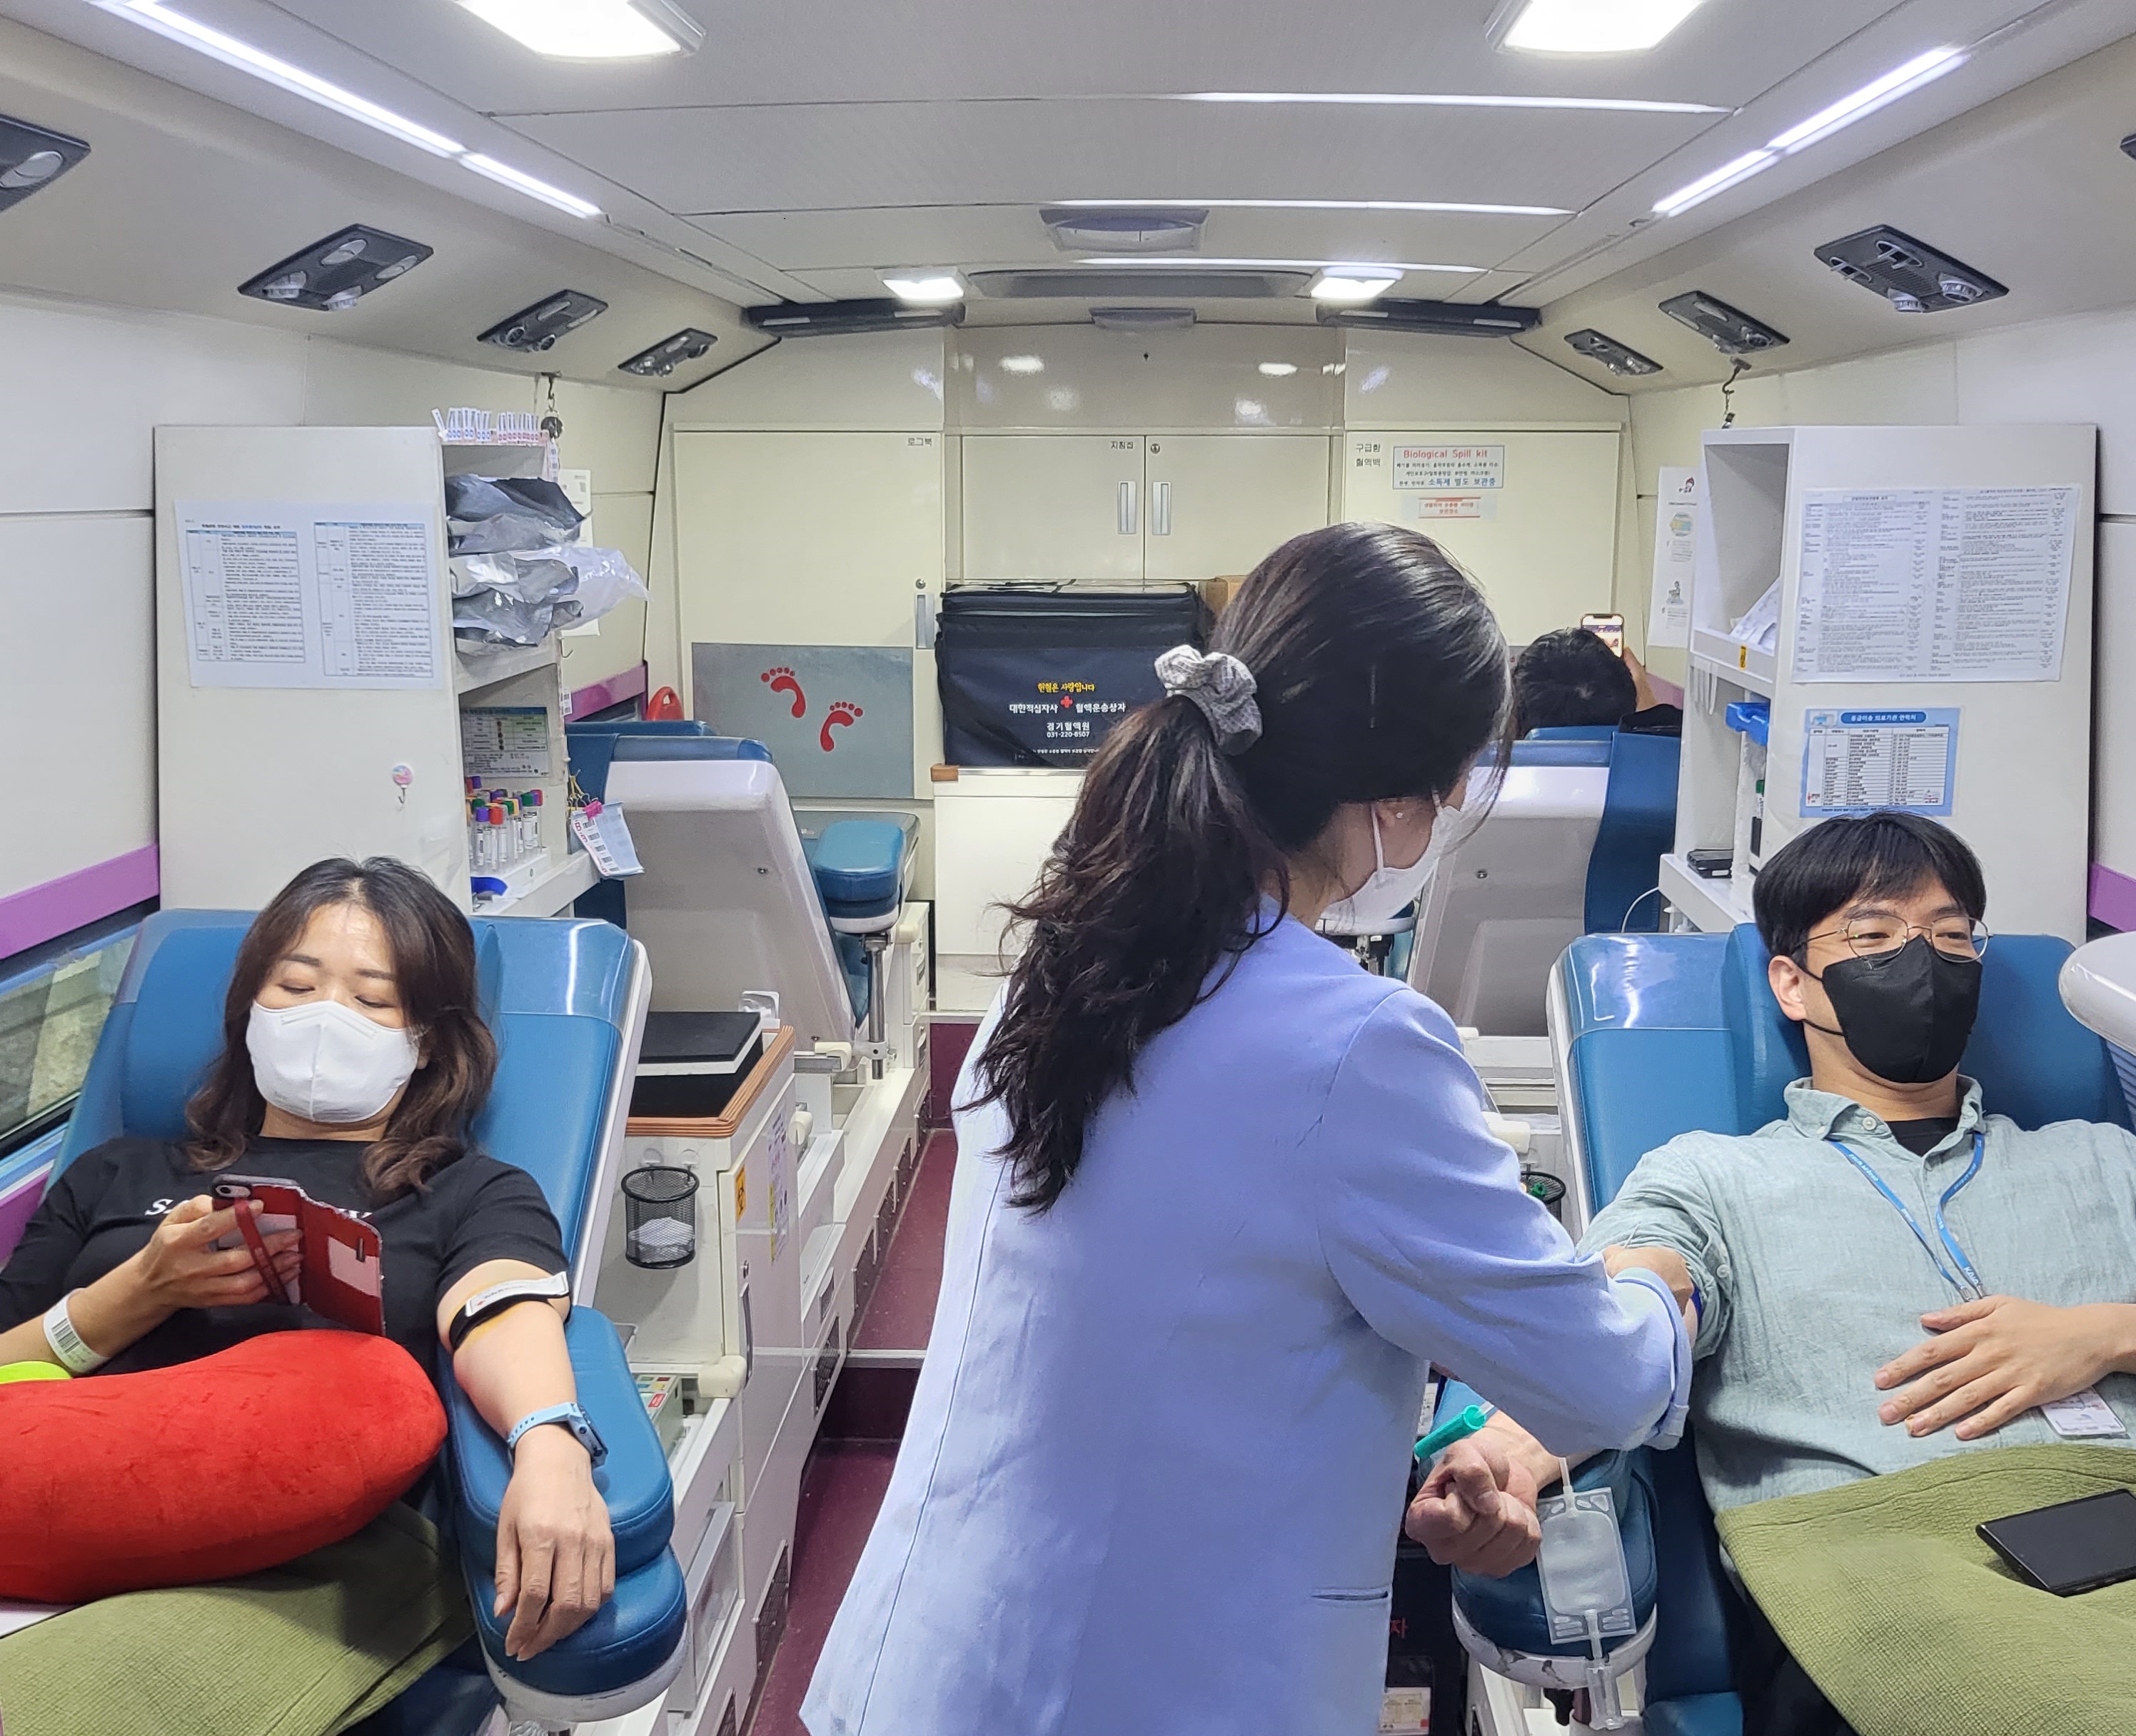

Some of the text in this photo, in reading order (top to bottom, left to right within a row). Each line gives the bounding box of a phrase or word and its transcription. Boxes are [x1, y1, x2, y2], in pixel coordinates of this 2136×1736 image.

[907, 438, 932, 447] 로그북
[1111, 441, 1134, 450] 지침집
[1356, 443, 1381, 453] 구급함
[1404, 448, 1488, 459] Biological Spill kit
[1356, 458, 1381, 468] 혈액백
[1428, 478, 1451, 487] 소독제
[1455, 478, 1469, 486] 별도
[1473, 478, 1496, 487] 보관중
[1037, 681, 1096, 693] 헌혈은 사랑입니다
[1009, 703, 1126, 714] 대한적십자사 혈액운송상자
[1047, 722, 1090, 732] 경기혈액원
